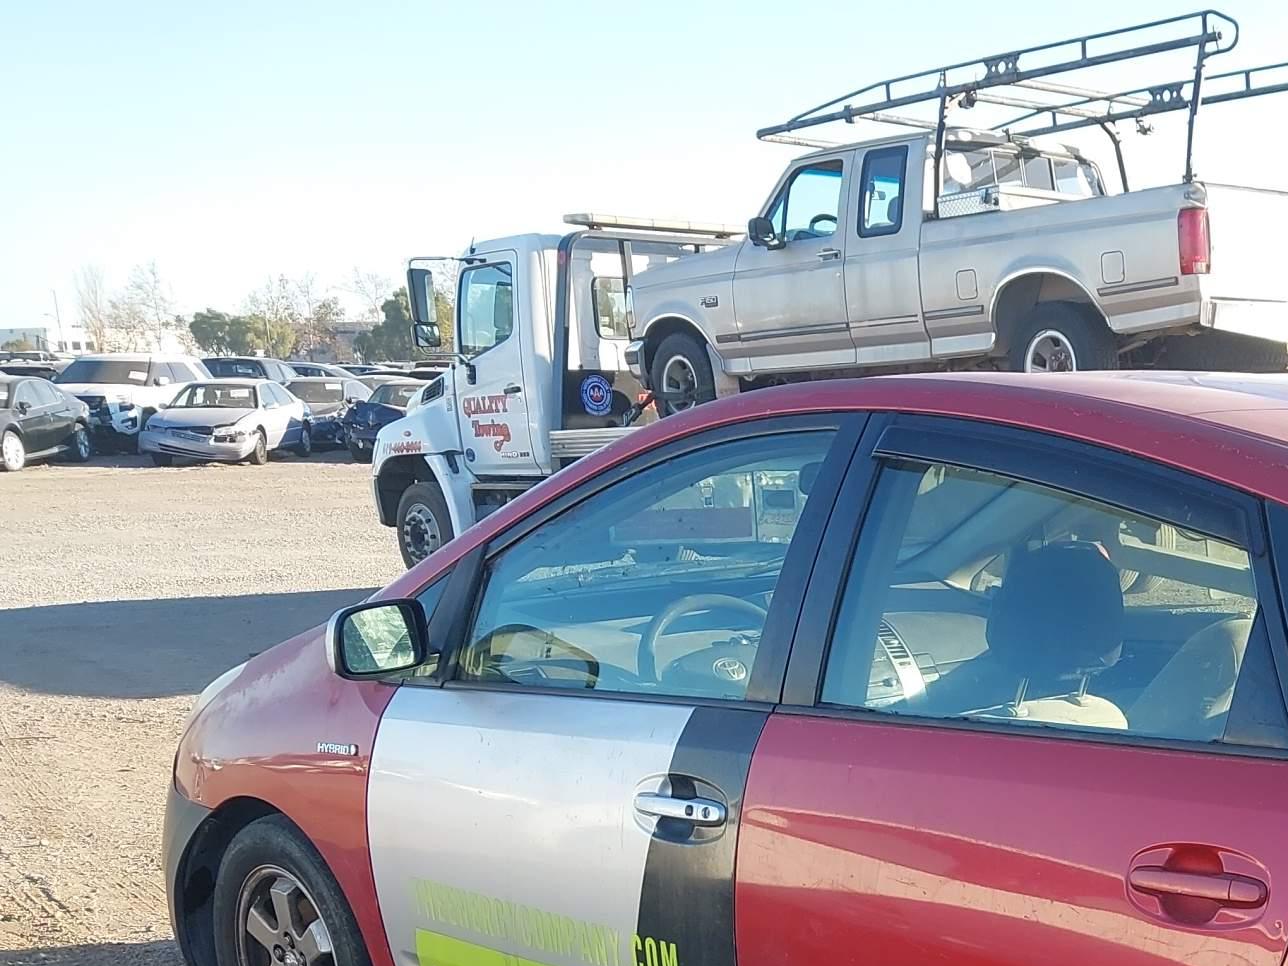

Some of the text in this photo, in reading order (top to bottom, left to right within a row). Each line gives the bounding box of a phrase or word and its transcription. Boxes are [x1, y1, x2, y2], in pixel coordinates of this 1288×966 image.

[463, 395, 508, 418] QUALITY
[471, 418, 511, 452] Towing
[317, 742, 349, 756] HYBRID
